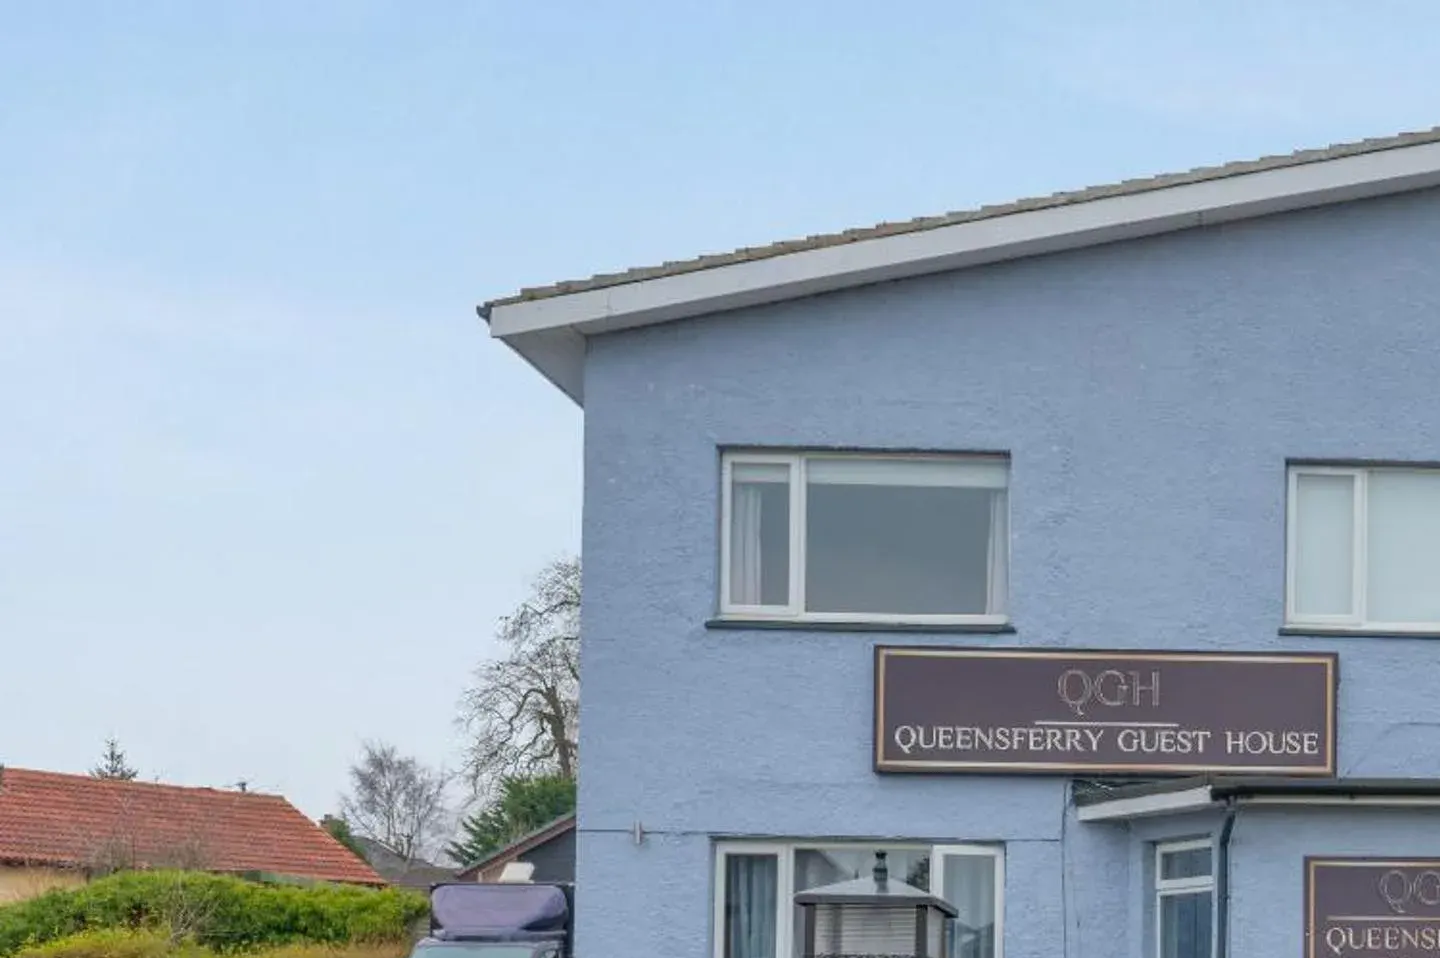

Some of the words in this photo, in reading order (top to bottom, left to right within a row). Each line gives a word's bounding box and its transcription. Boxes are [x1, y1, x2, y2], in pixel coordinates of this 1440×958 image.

[1057, 669, 1160, 715] QGH
[894, 725, 1104, 754] QUEENSFERRY
[1117, 729, 1211, 755] GUEST
[1226, 731, 1319, 755] HOUSE
